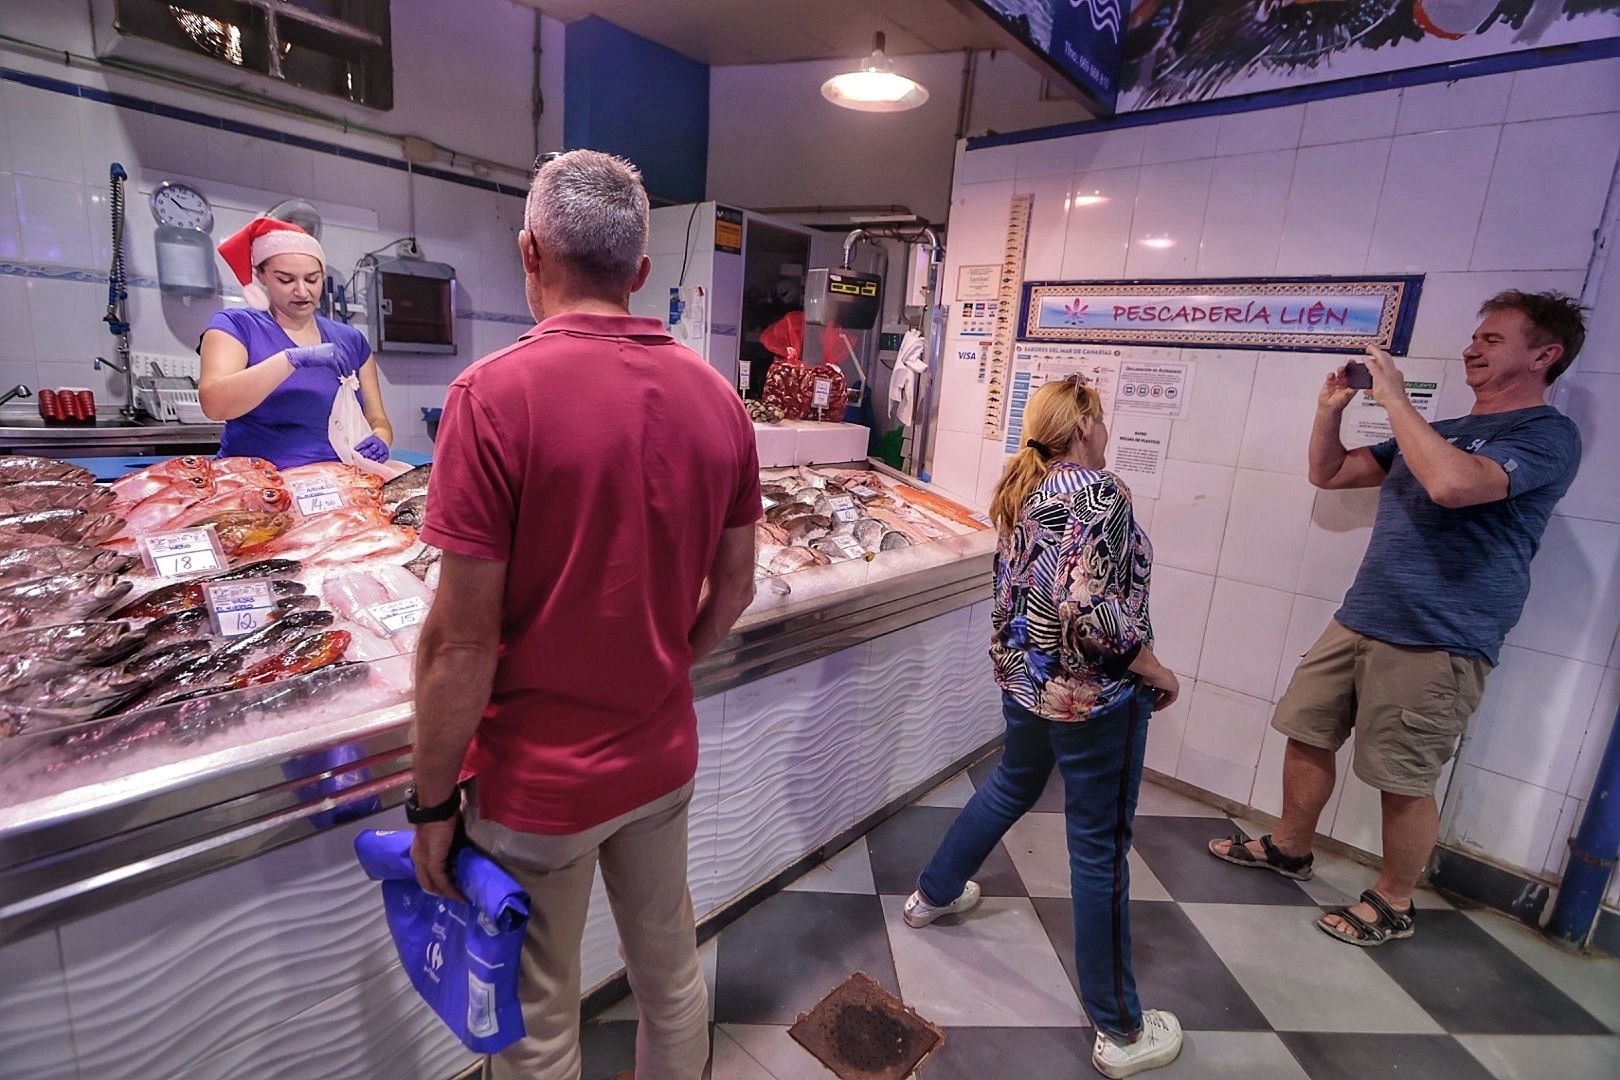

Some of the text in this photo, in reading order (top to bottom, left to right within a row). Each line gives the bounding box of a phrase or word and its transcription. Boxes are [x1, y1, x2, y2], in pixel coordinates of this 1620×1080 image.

[1113, 301, 1349, 326] PESCADERÍA LIÊN
[958, 352, 976, 360] VISA
[176, 556, 192, 572] 18
[237, 612, 257, 630] 12
